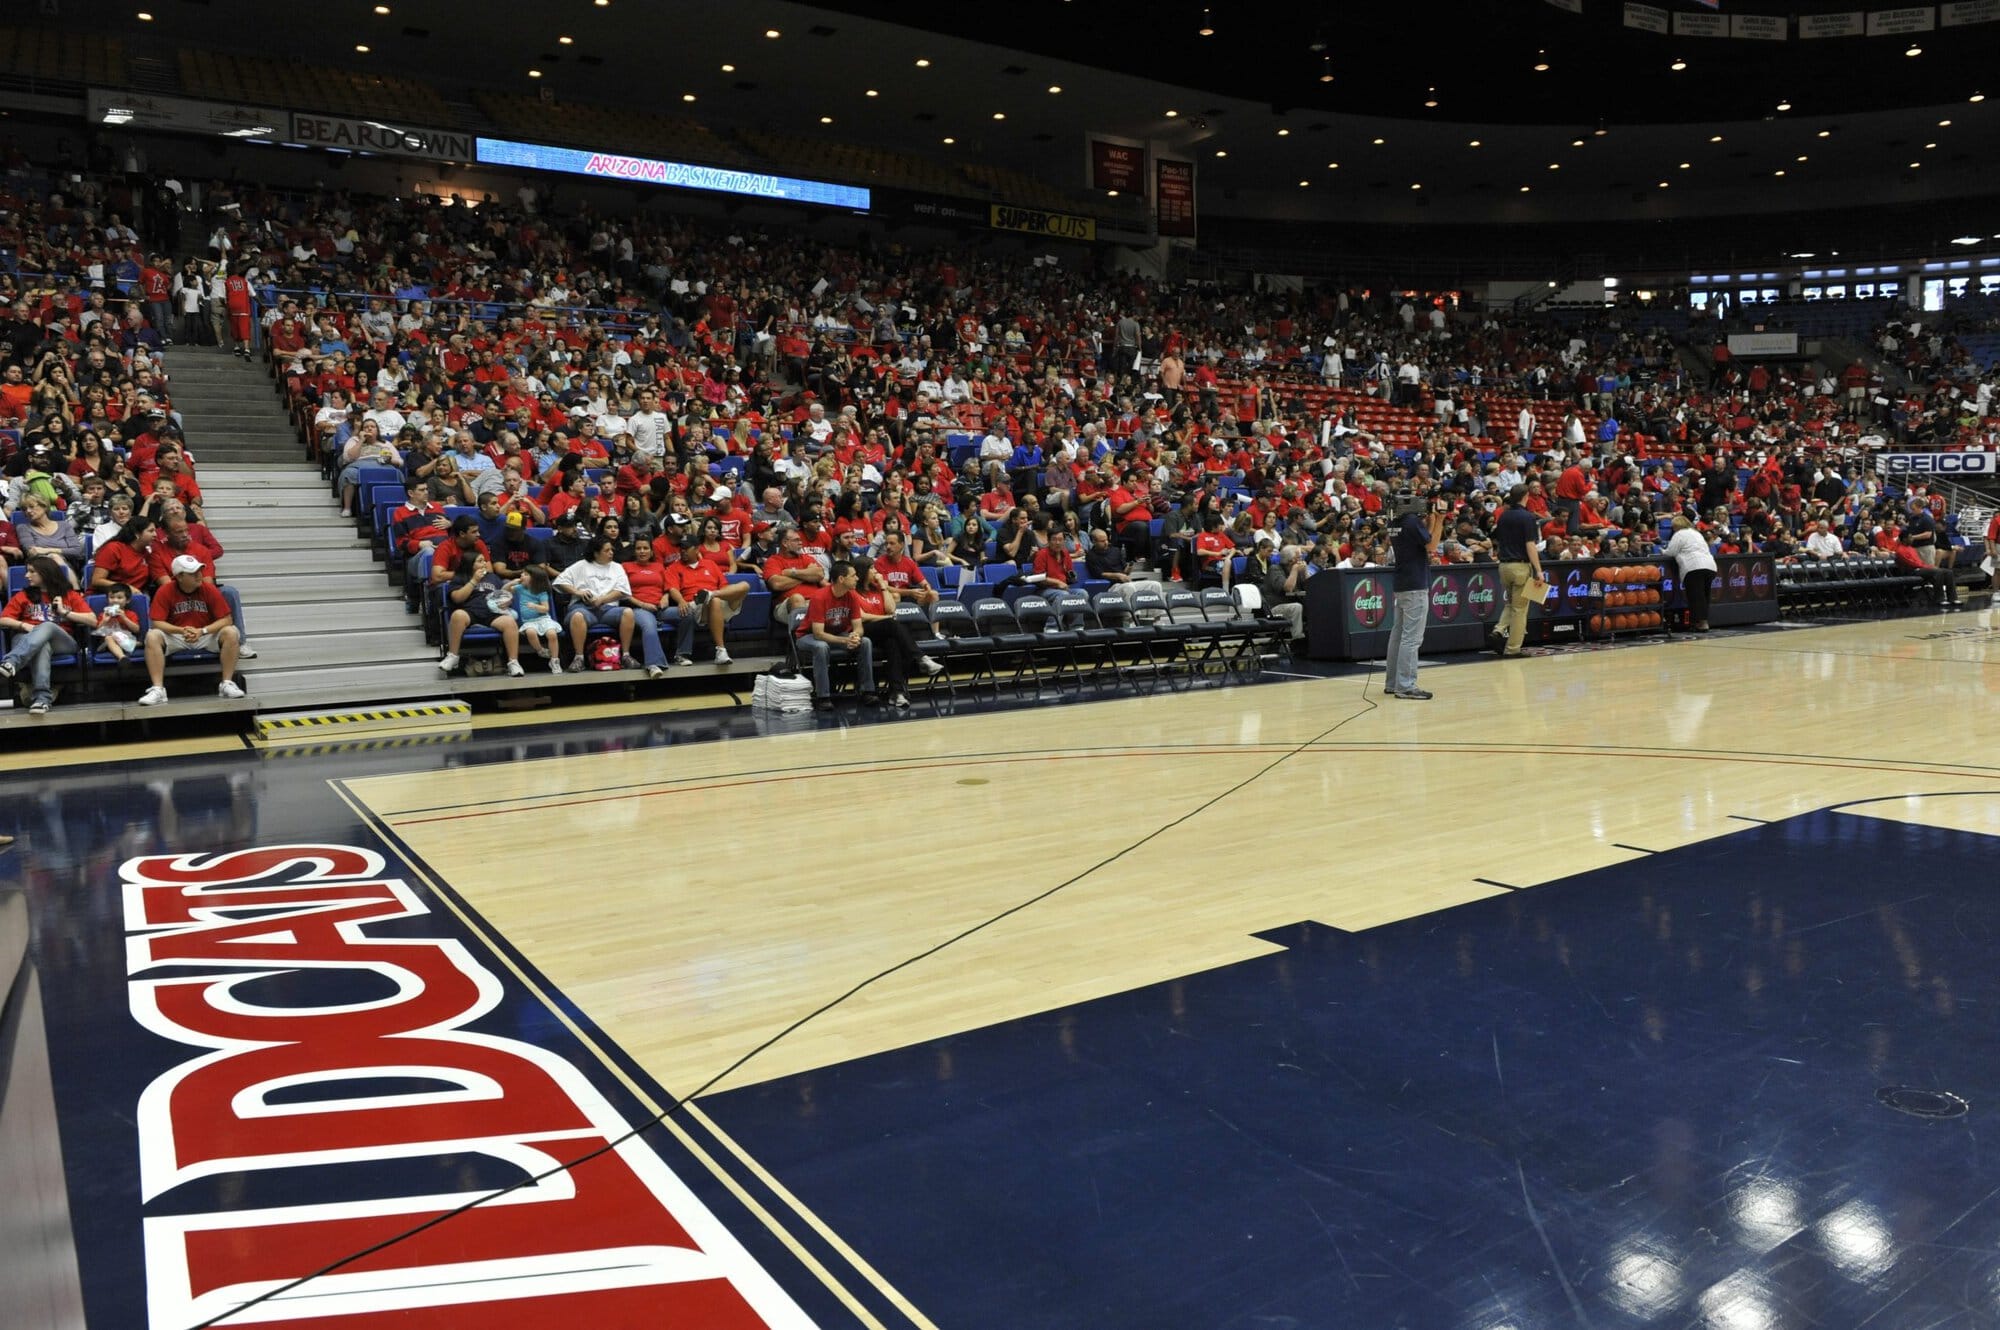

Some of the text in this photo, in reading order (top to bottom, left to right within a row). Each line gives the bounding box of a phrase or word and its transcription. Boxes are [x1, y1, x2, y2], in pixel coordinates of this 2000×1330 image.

[1109, 149, 1129, 161] WAC
[913, 201, 957, 217] verion
[995, 206, 1088, 238] SUPERCUTS
[1887, 453, 1986, 473] GEICO
